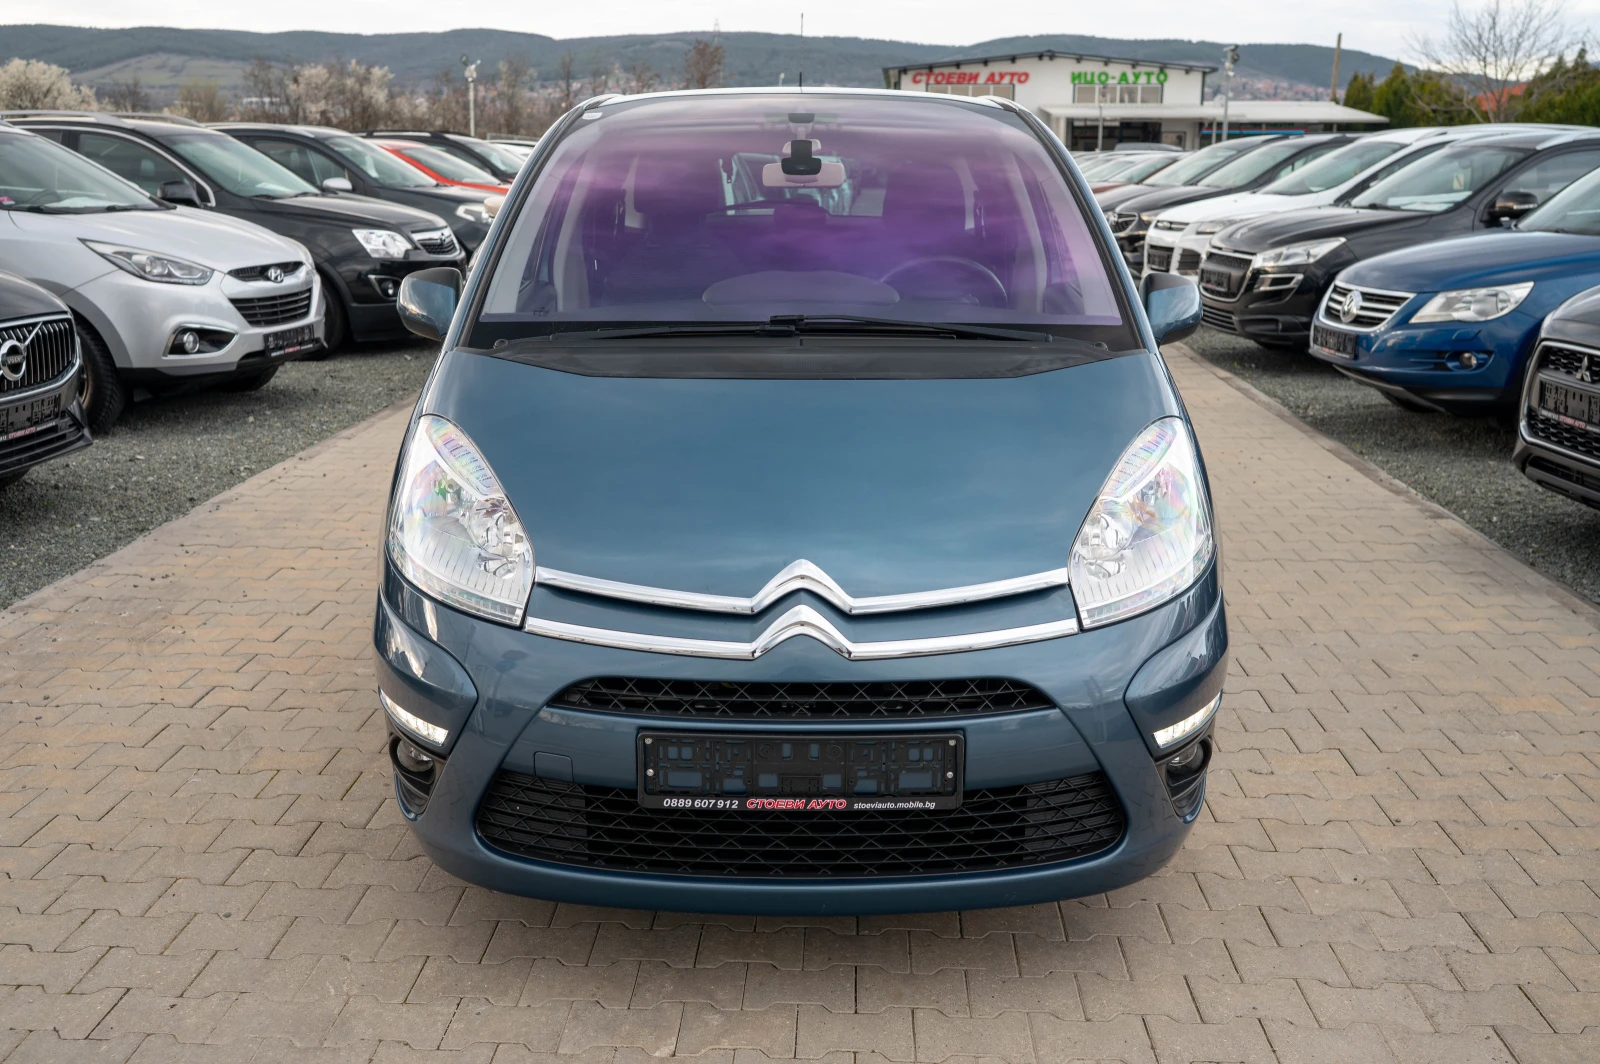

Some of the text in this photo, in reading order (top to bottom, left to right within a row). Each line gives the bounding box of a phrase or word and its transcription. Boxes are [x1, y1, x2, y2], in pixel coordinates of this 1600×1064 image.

[912, 72, 1029, 84] СТОЕВИ АУТО
[1071, 71, 1168, 84] ИЦО-АУТО
[663, 798, 936, 810] 0889 607 912 СТОЕВИ АУТО stoeviauto.mobile.bg
